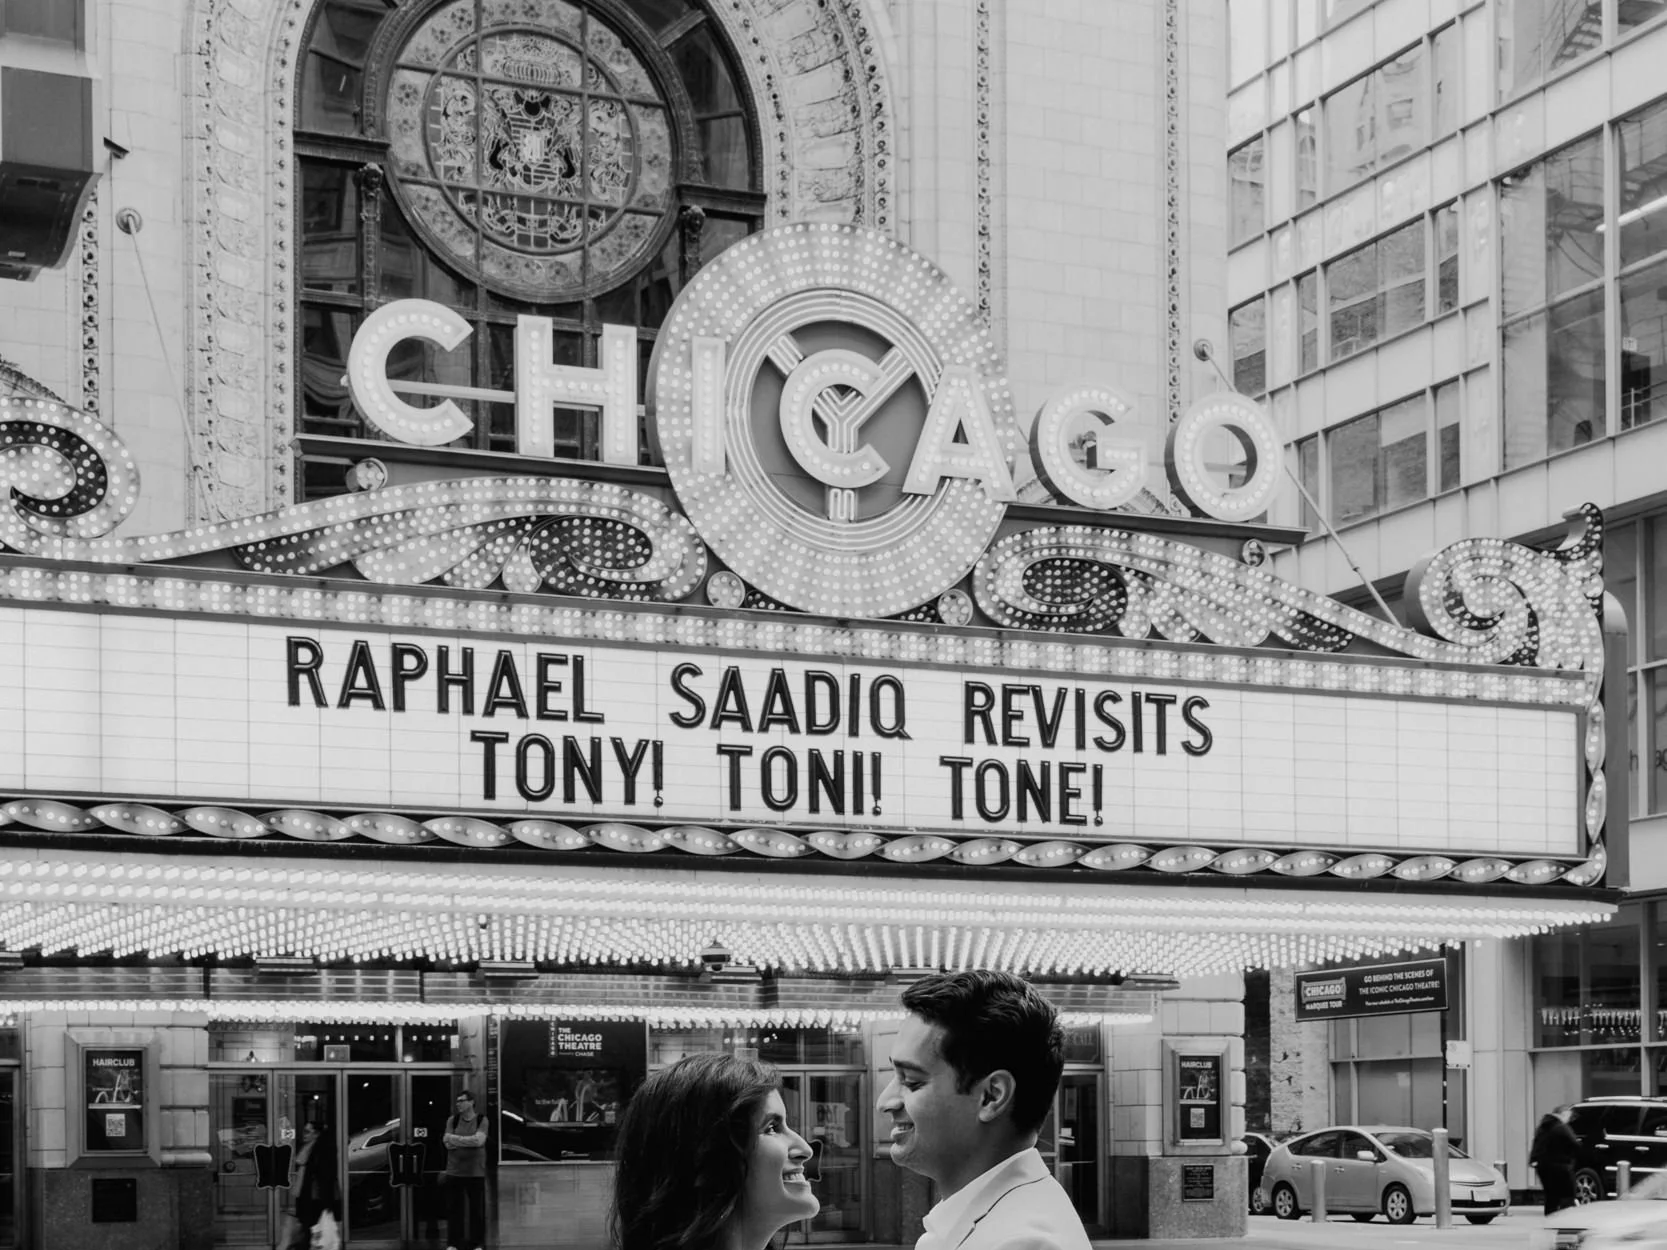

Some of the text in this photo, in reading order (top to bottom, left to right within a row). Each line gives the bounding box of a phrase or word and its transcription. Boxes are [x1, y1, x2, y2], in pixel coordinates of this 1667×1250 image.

[346, 299, 1284, 522] CHICAGO
[286, 635, 1213, 757] RAPHAEL SAADIQ REVISITS
[470, 730, 1104, 827] TONY! TONI! TONE!
[1373, 973, 1393, 983] BEHIND
[1393, 972, 1404, 980] THE
[1405, 970, 1425, 979] SCENES
[1425, 968, 1434, 977] OF
[1305, 984, 1341, 997] CHICAGO
[1359, 987, 1369, 995] THE
[1370, 985, 1388, 994] ICONIC
[1389, 982, 1414, 993] CHICAGO
[1329, 1000, 1343, 1009] TOUR
[557, 1033, 602, 1042] CHICAGO
[557, 1042, 602, 1050] THEATRE
[92, 1058, 135, 1067] HAIRCLUB
